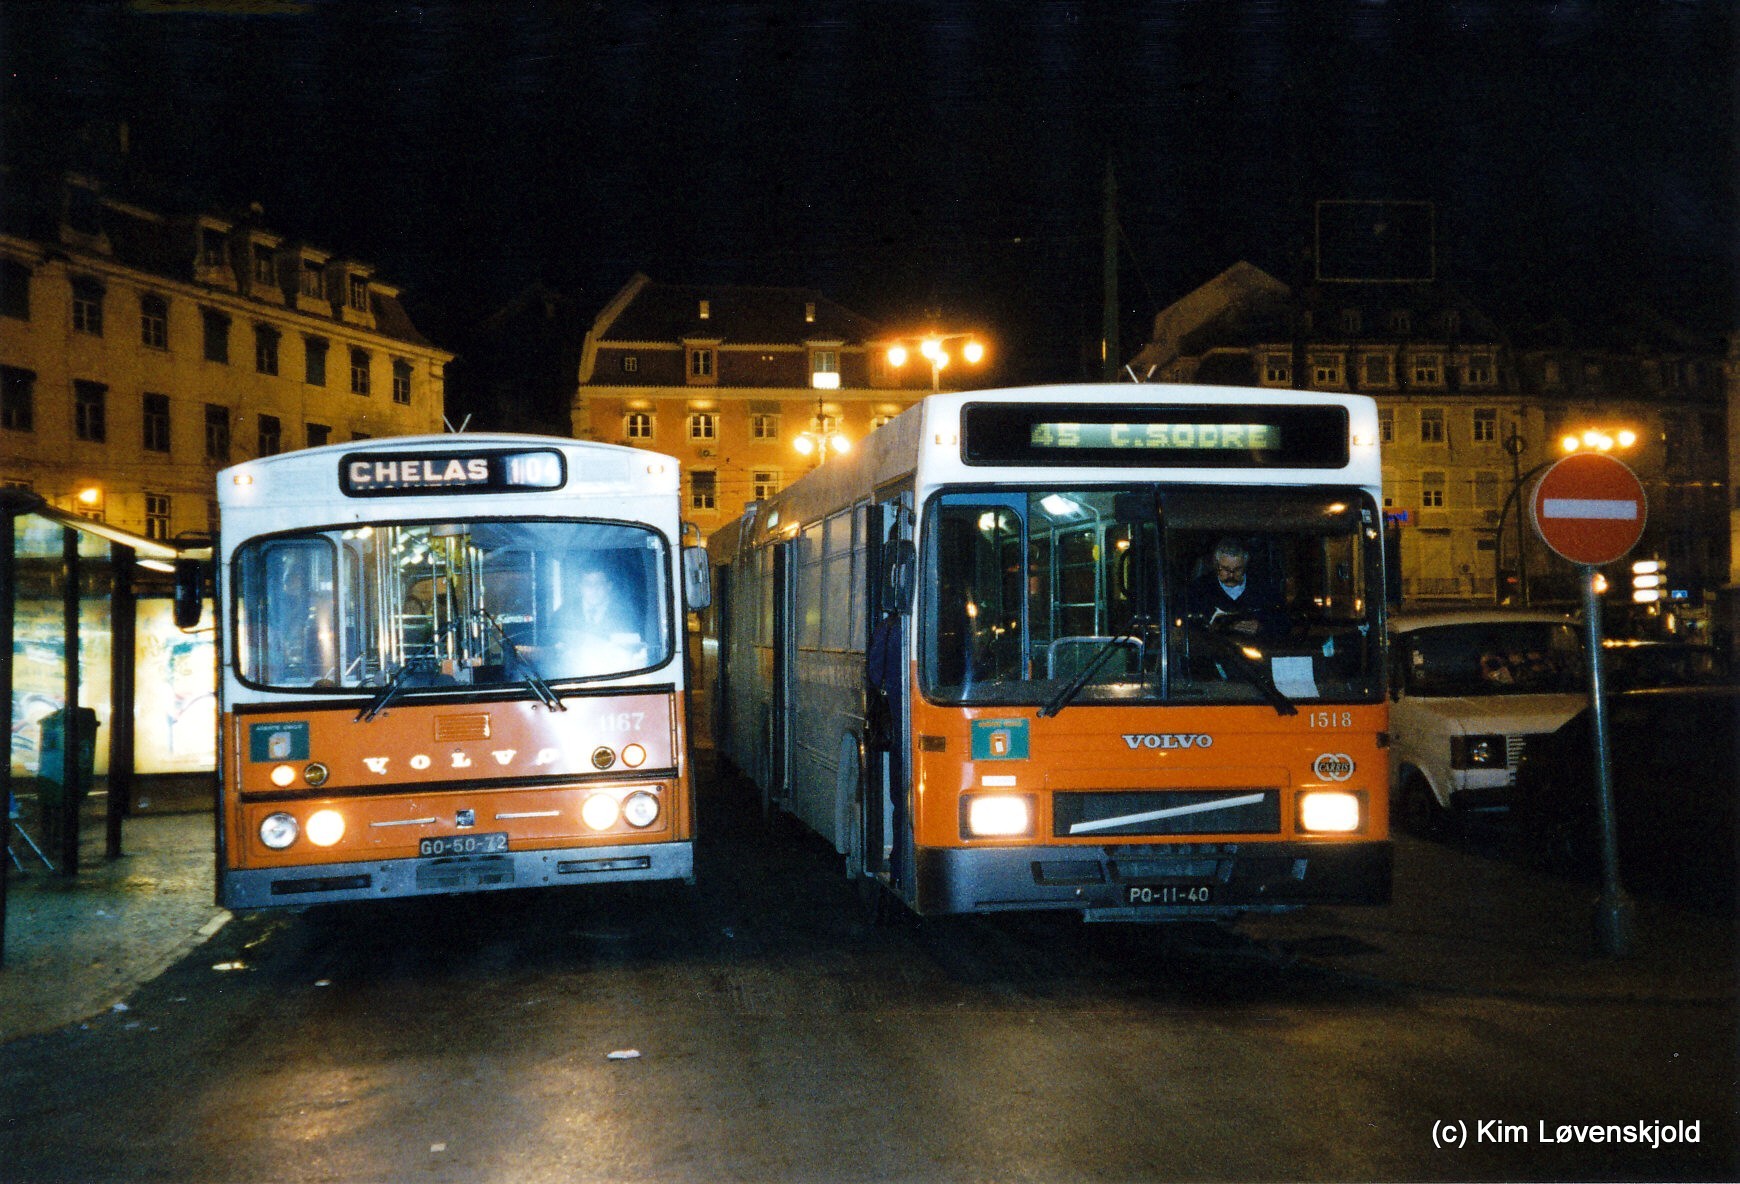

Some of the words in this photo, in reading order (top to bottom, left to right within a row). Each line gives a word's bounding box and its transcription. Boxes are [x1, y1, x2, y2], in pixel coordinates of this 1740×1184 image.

[1031, 423, 1080, 446] 45
[1111, 424, 1267, 447] C.SODRE
[350, 459, 488, 482] CHELAS
[600, 711, 645, 731] 1167
[1310, 711, 1352, 727] 1518
[1121, 734, 1213, 749] VOLVO
[363, 748, 558, 774] VOLVO
[421, 835, 507, 855] GO-50-72
